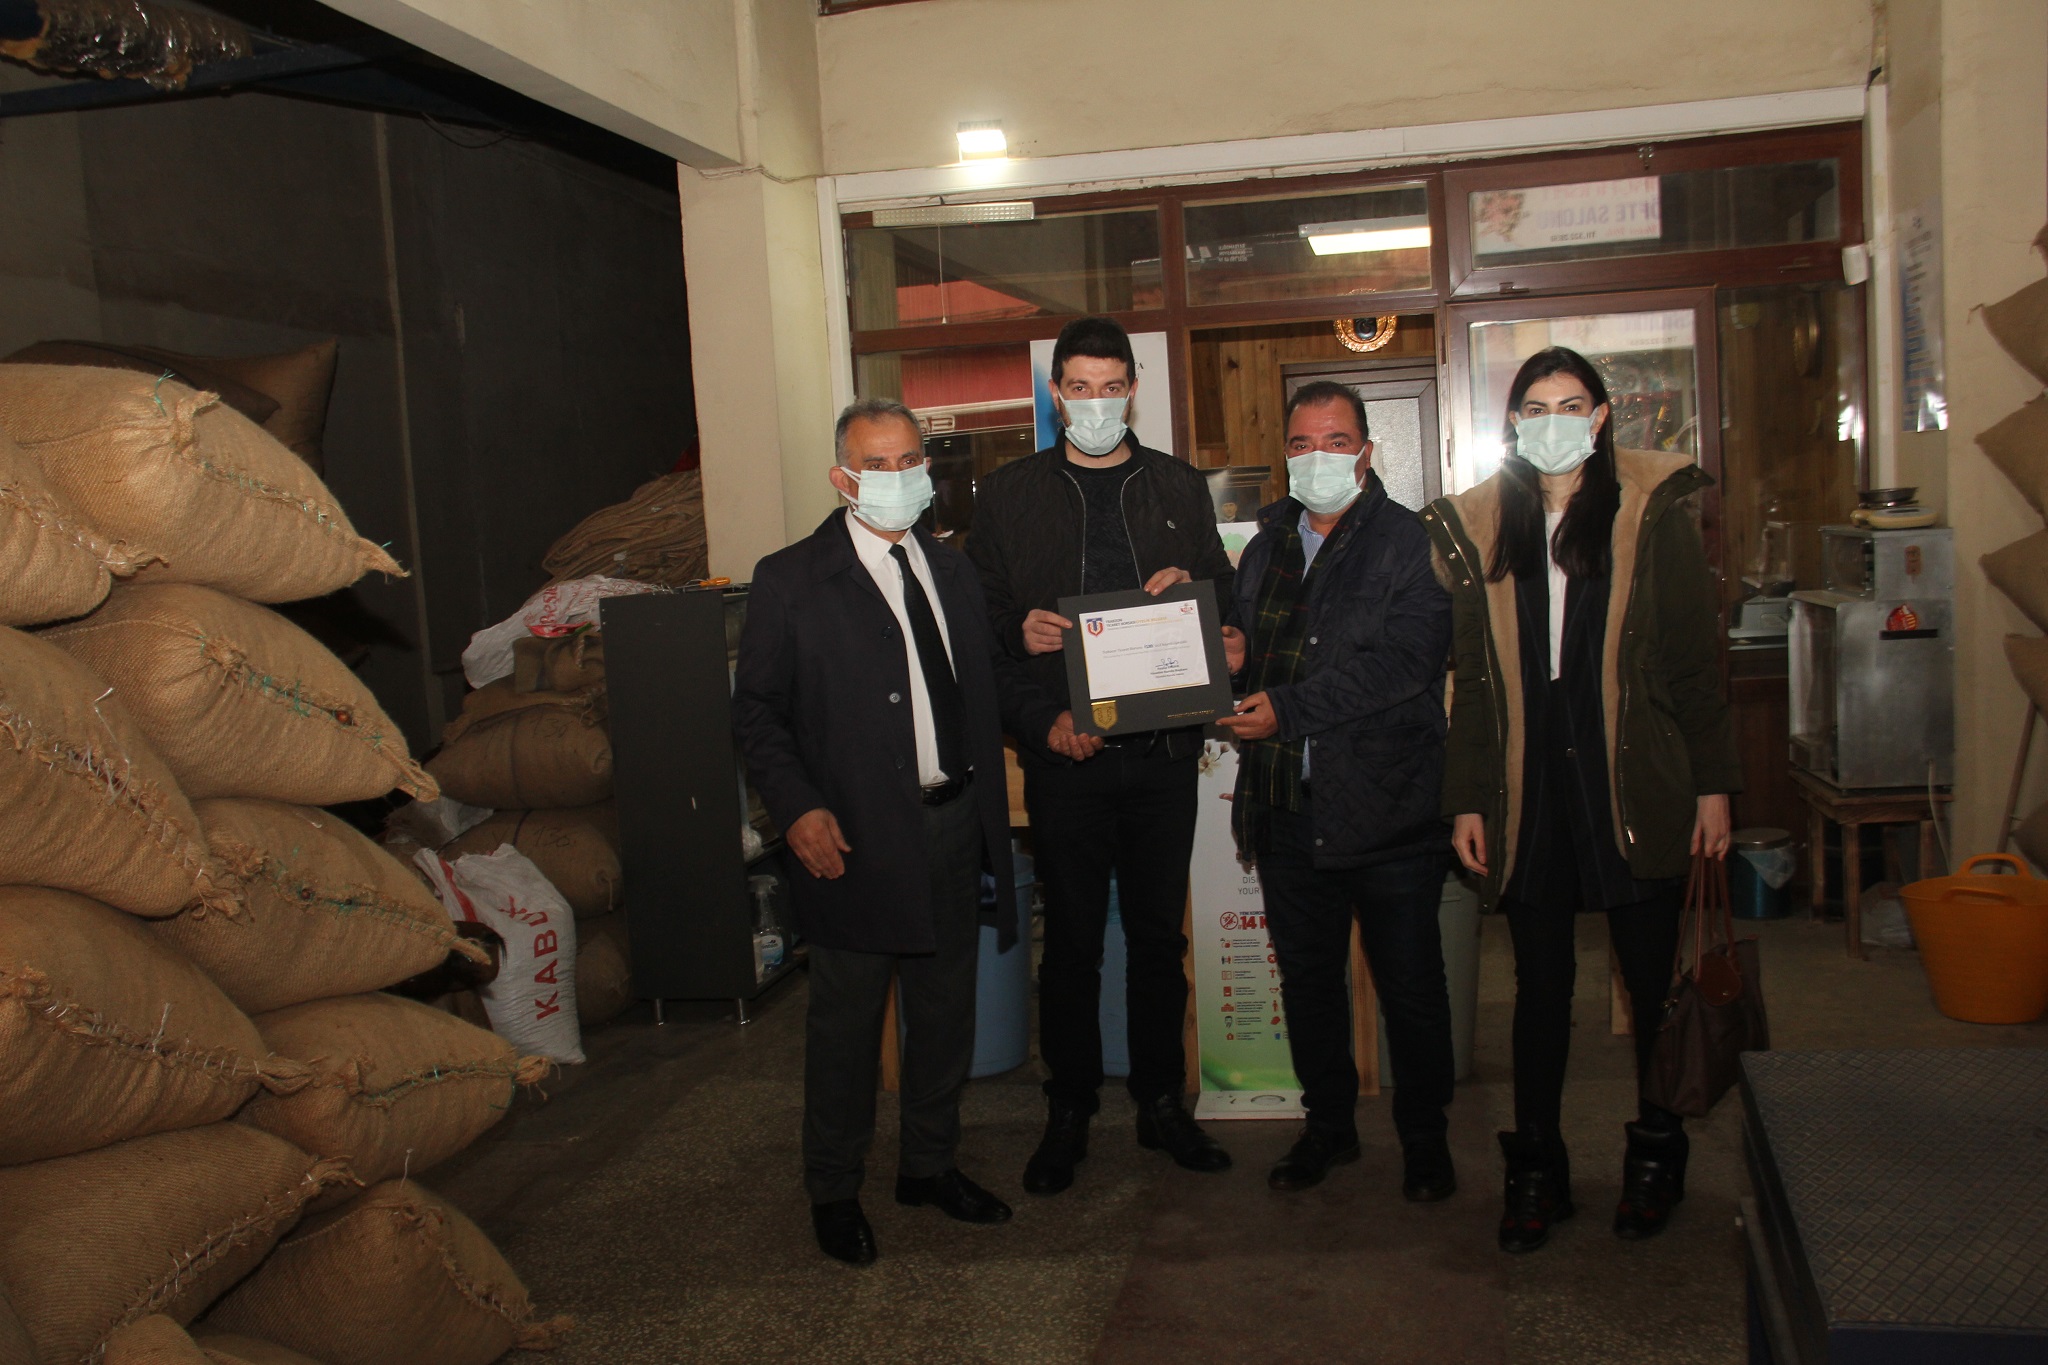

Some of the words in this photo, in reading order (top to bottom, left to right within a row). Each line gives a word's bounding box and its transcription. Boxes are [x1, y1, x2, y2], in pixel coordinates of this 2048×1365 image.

[1237, 887, 1260, 895] YOUR
[1240, 915, 1257, 930] 14
[499, 895, 560, 1020] KABUK
